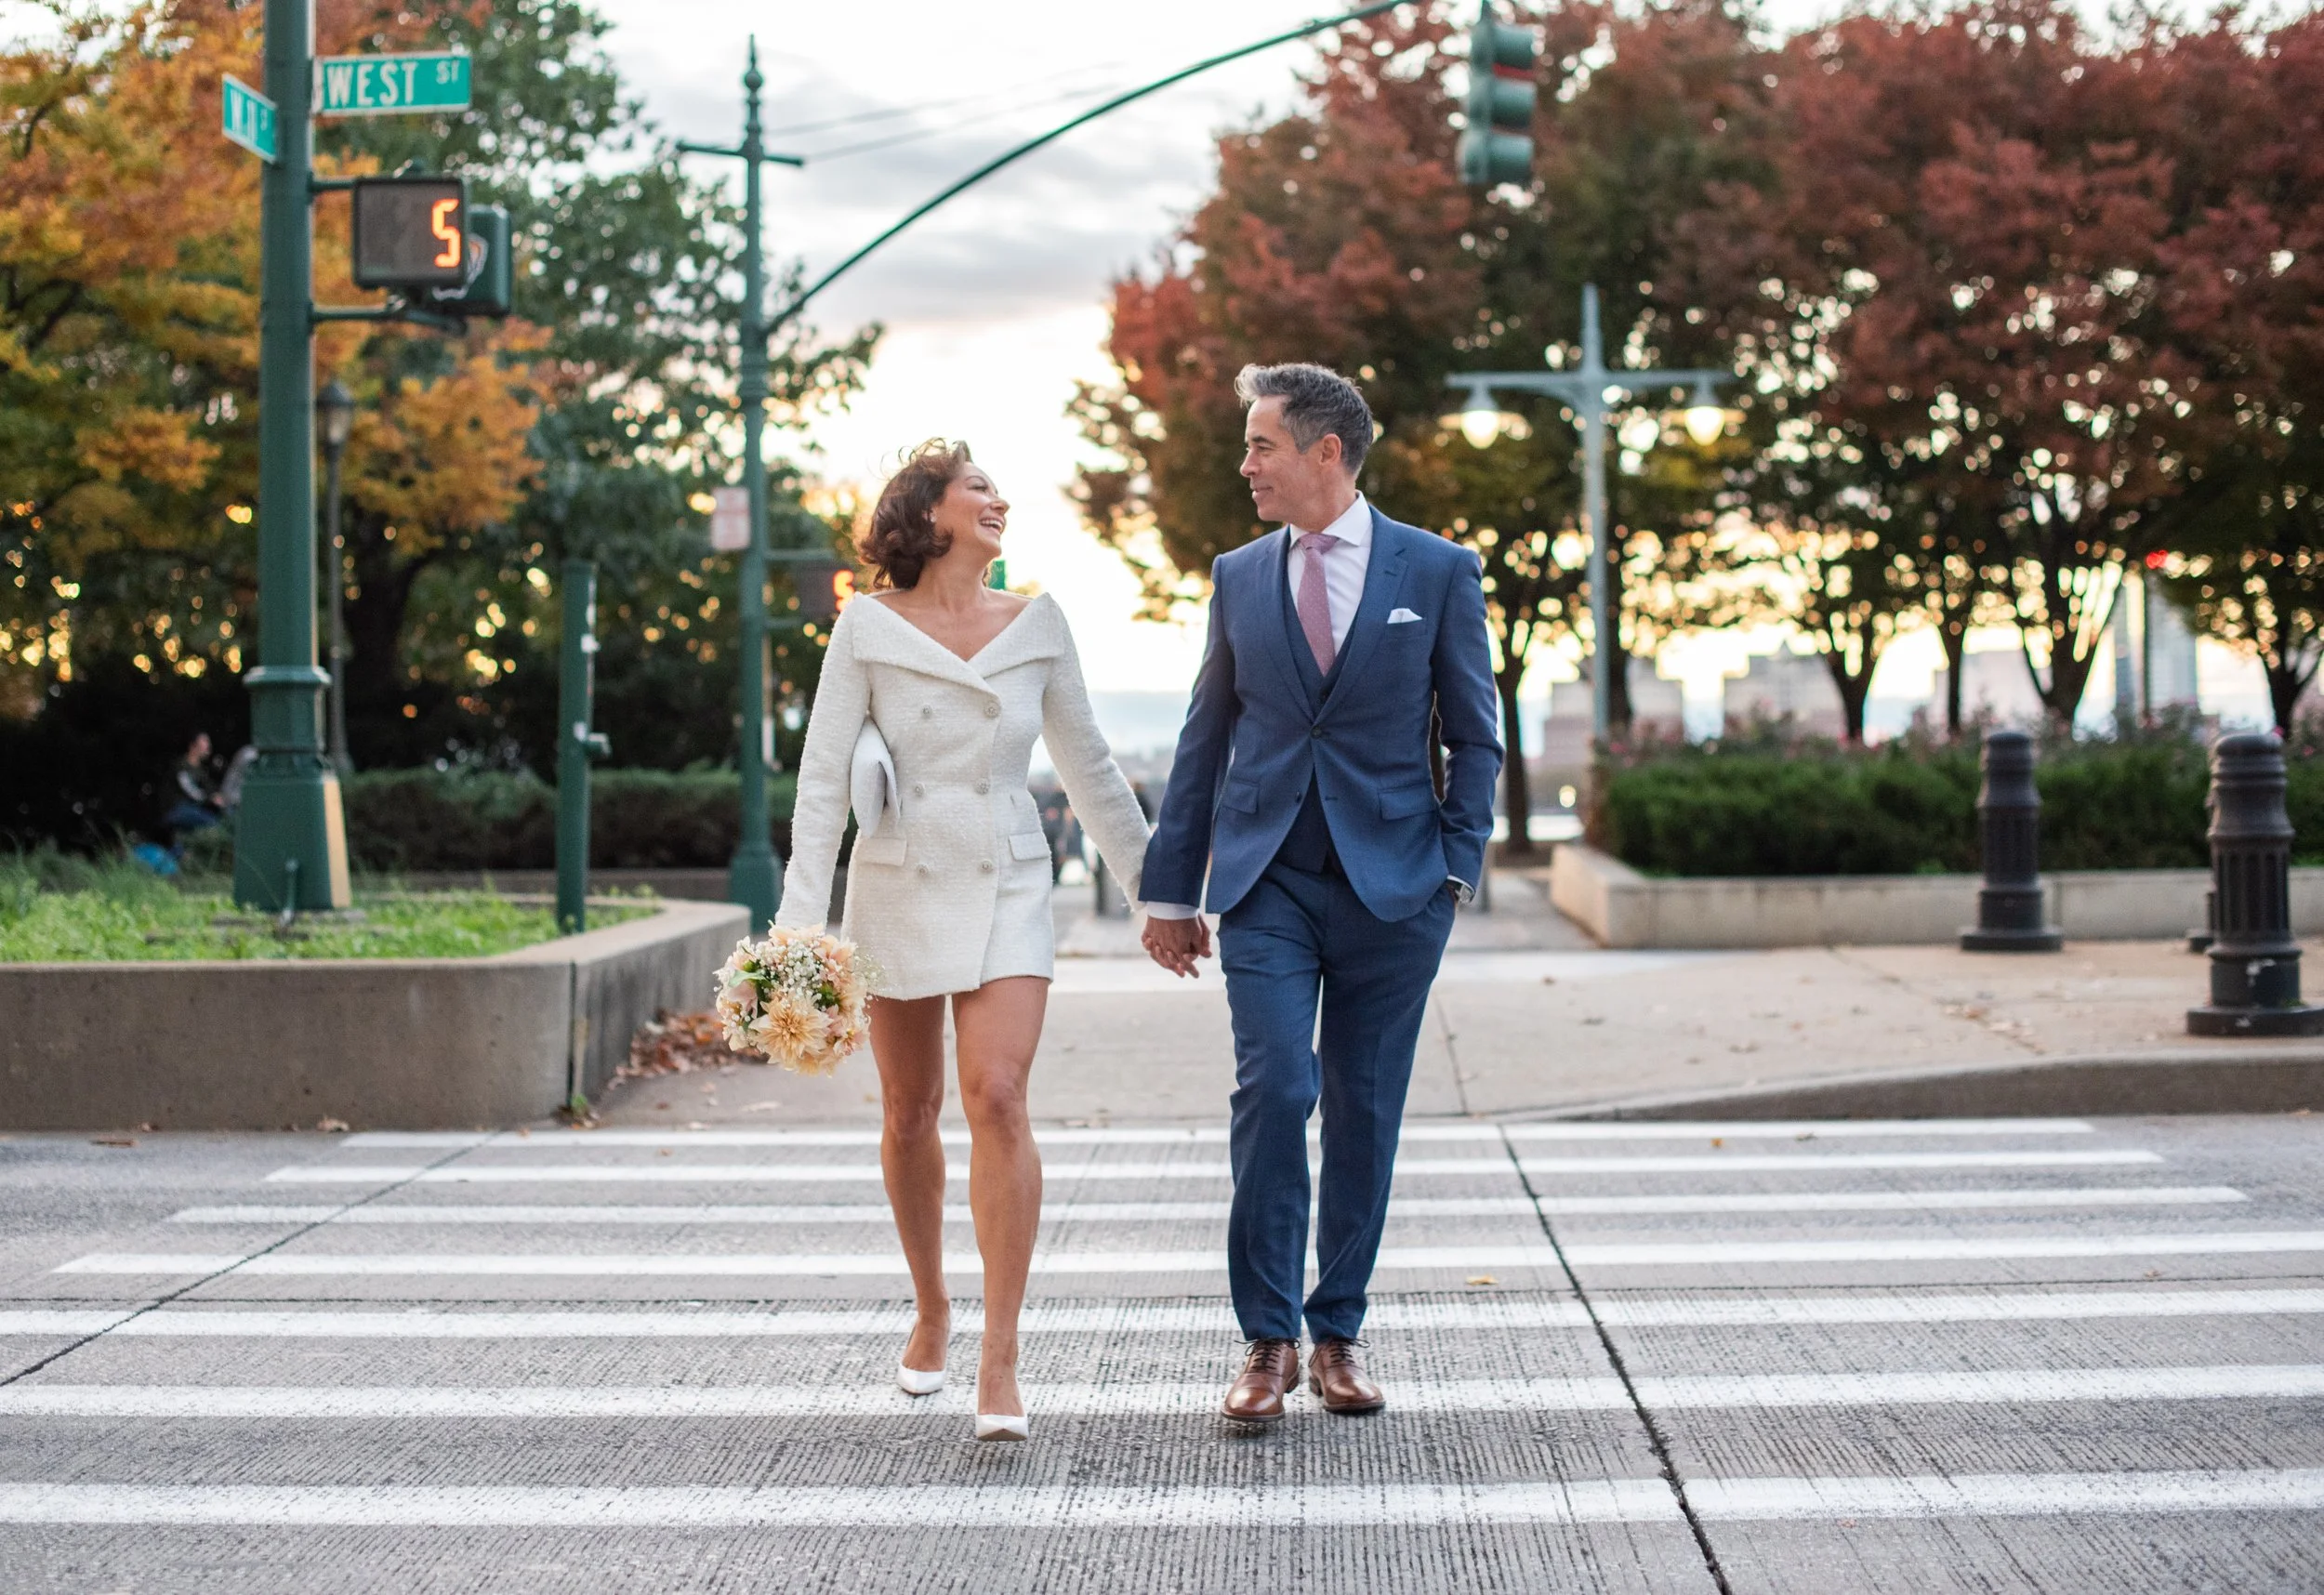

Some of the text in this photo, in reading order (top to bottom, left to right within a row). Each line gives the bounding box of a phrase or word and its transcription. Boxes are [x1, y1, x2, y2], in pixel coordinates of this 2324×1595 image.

[327, 60, 460, 107] WEST ST
[432, 198, 460, 267] 5
